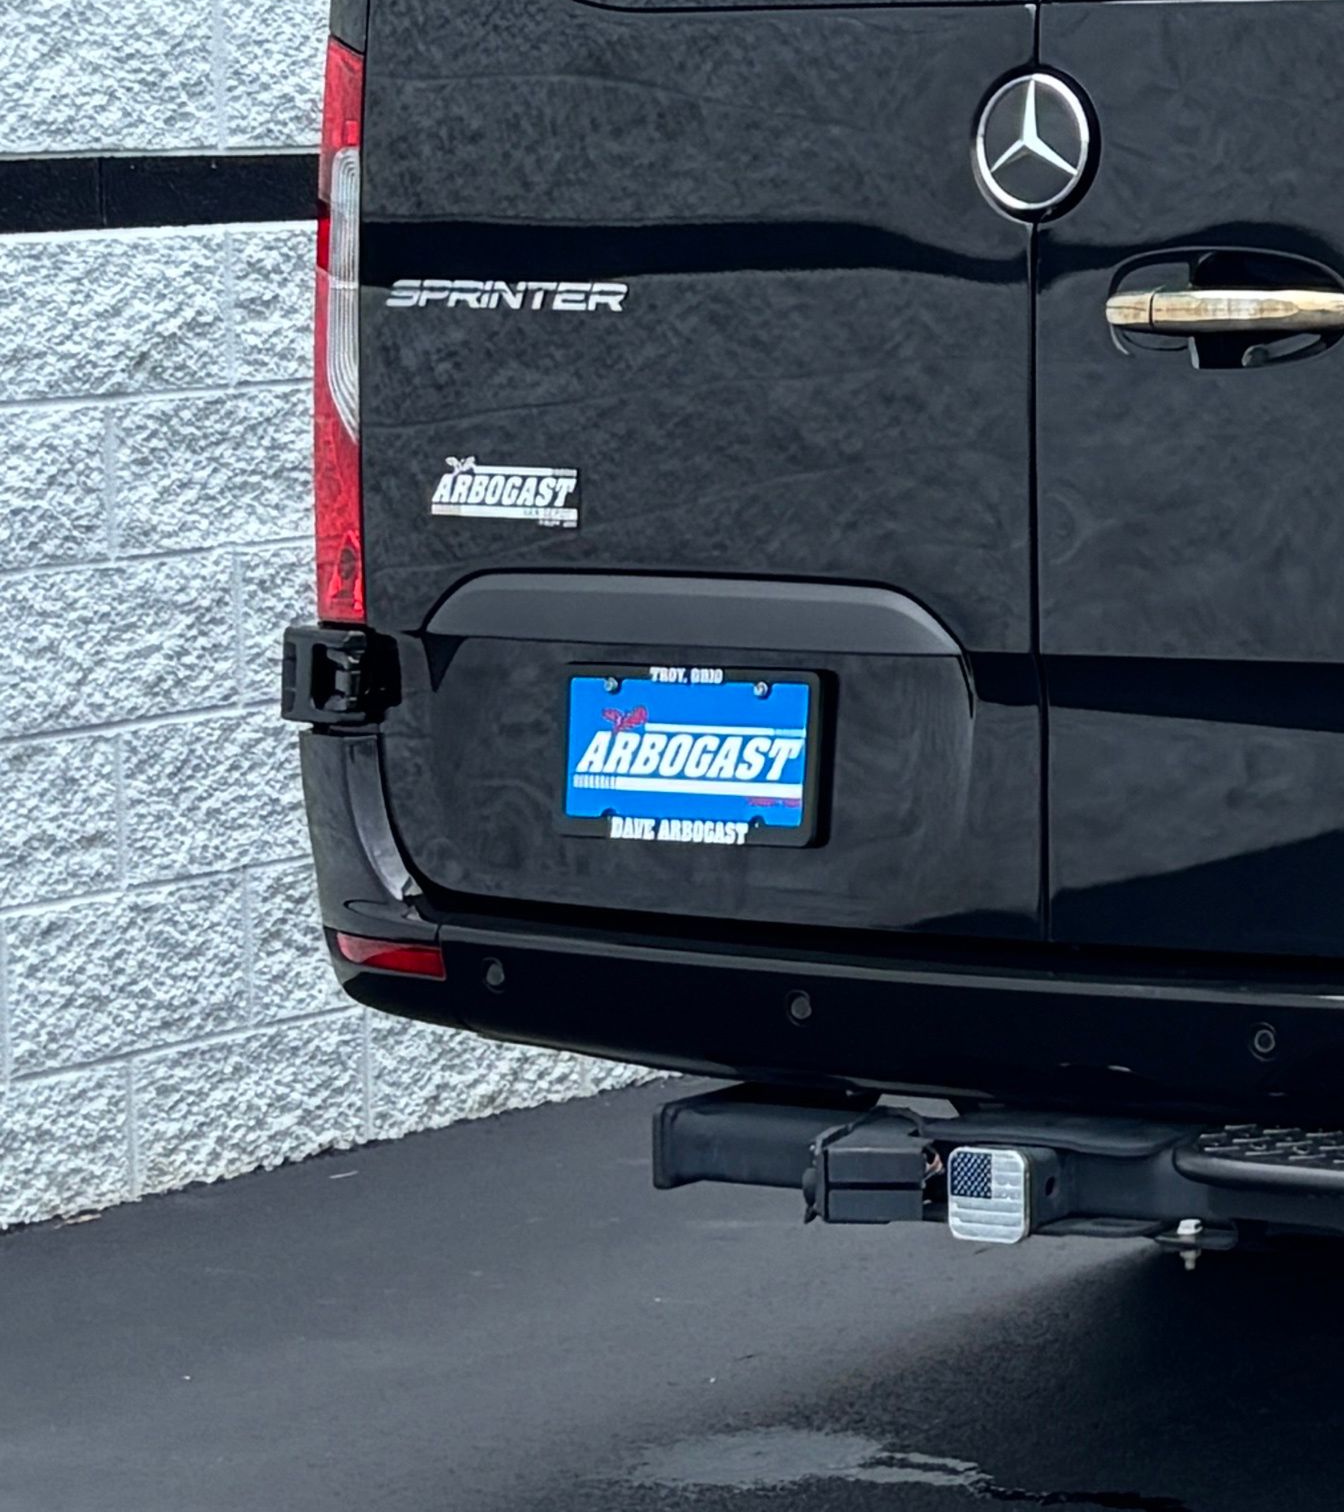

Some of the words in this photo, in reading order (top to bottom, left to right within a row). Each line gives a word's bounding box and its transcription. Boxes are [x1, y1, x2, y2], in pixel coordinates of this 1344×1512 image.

[386, 279, 628, 312] SPRINTER
[432, 473, 577, 507] ARBOGAST
[576, 730, 804, 781] ARBOGAST
[610, 817, 655, 840] DAVE
[657, 820, 748, 844] ARBOGAST
